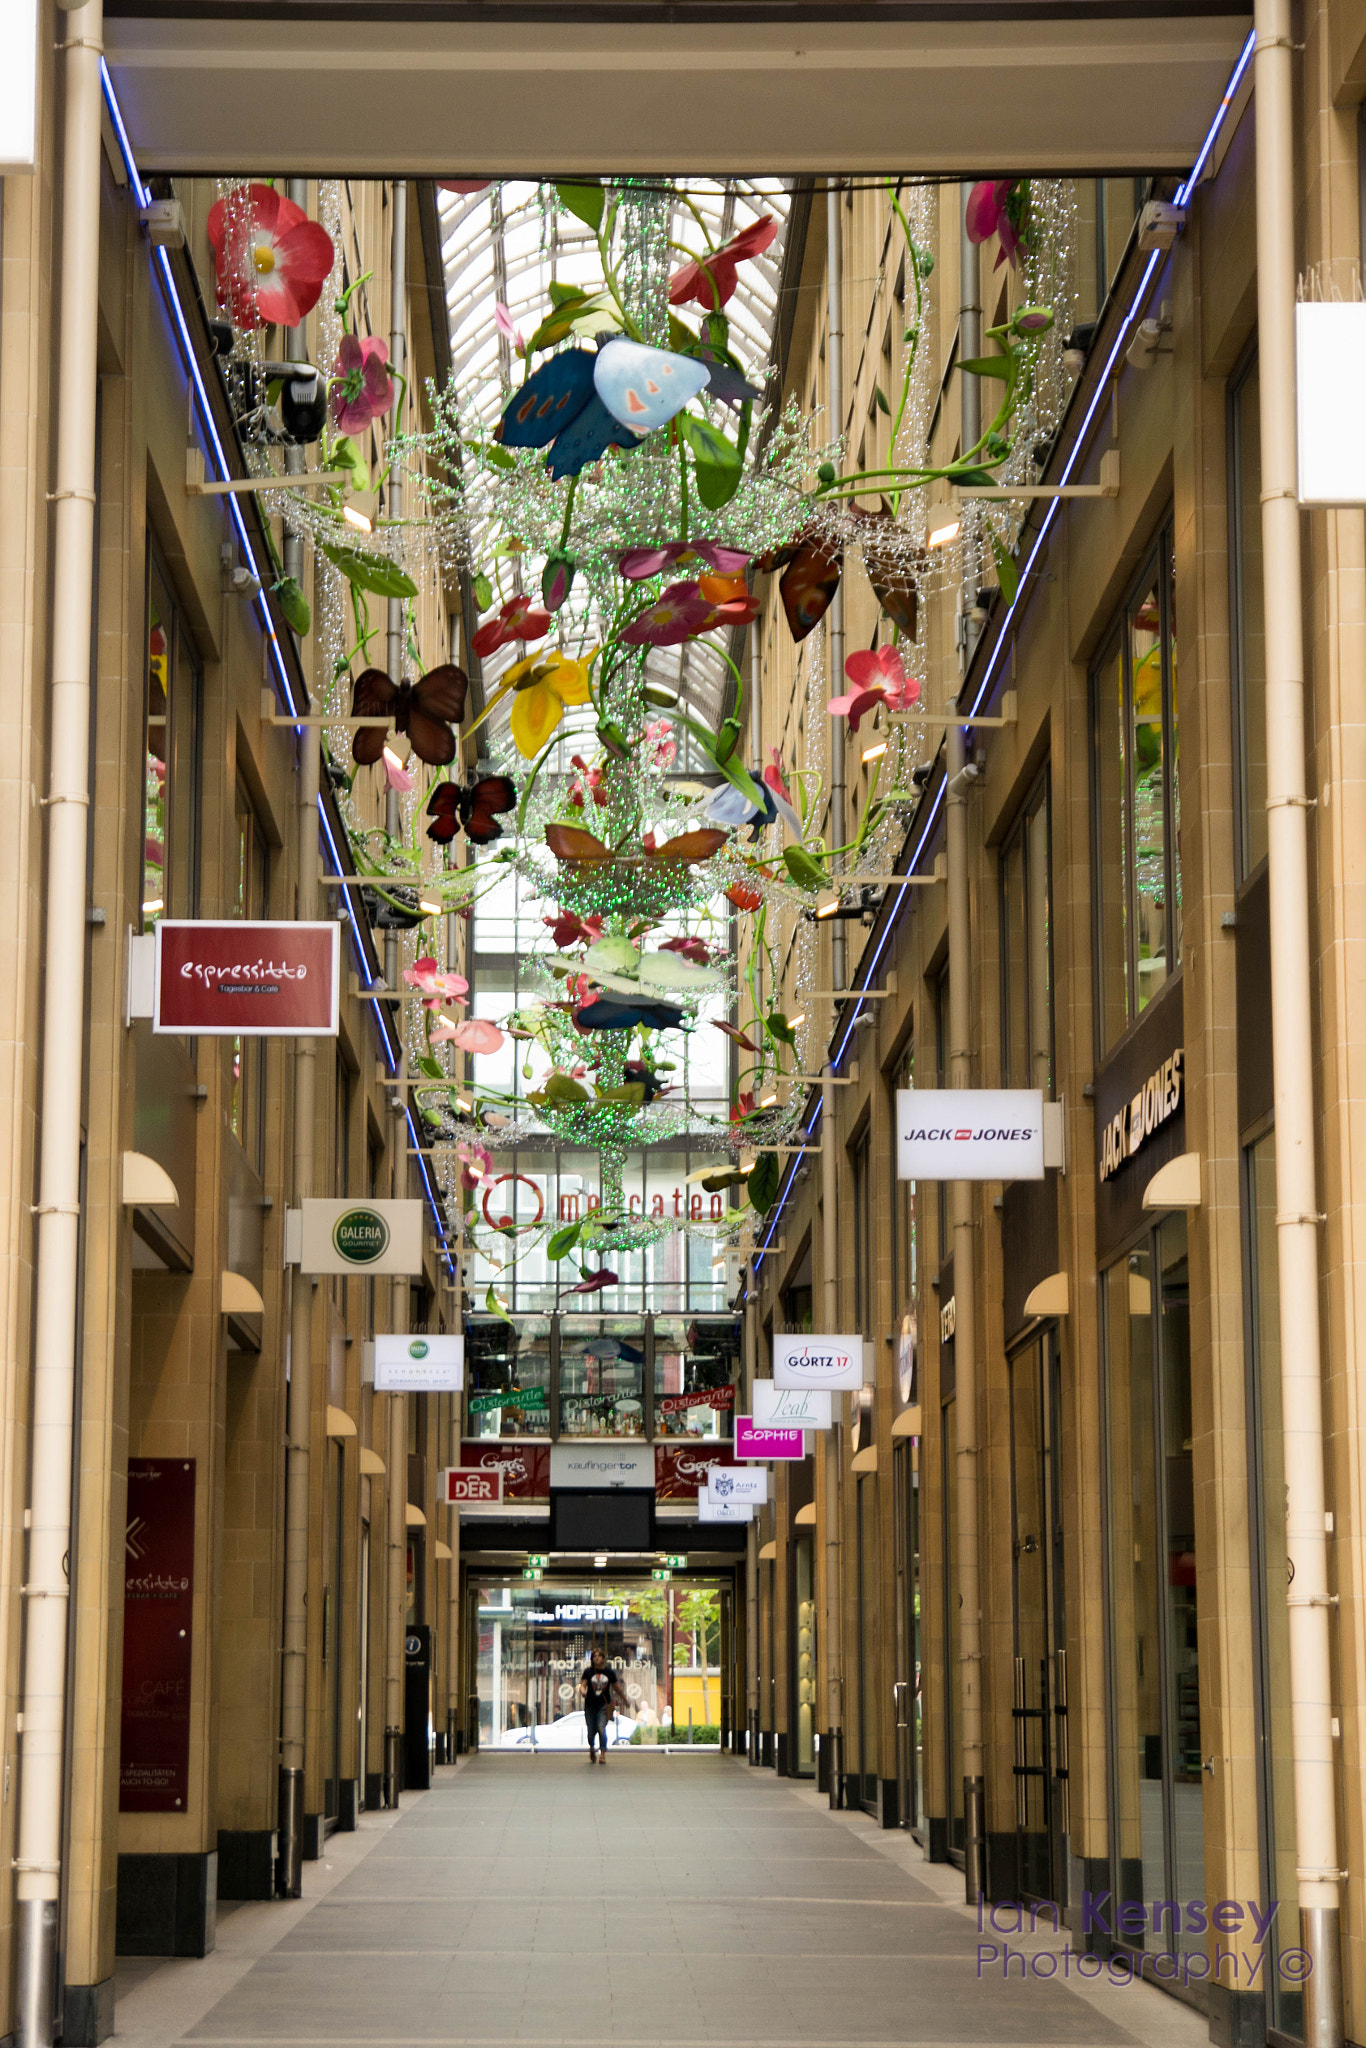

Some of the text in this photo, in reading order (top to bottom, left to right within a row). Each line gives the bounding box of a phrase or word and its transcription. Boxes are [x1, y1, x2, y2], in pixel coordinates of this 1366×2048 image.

[181, 960, 307, 988] espressitto
[220, 985, 252, 993] Tagesbar
[1100, 1048, 1184, 1182] JACK JONES
[904, 1129, 1033, 1141] JACK JONES
[560, 1187, 724, 1224] mecateo
[341, 1226, 382, 1239] GALERIA
[836, 1357, 848, 1367] 17
[741, 1430, 798, 1441] SOPHIE
[568, 1461, 637, 1471] kaufingertor
